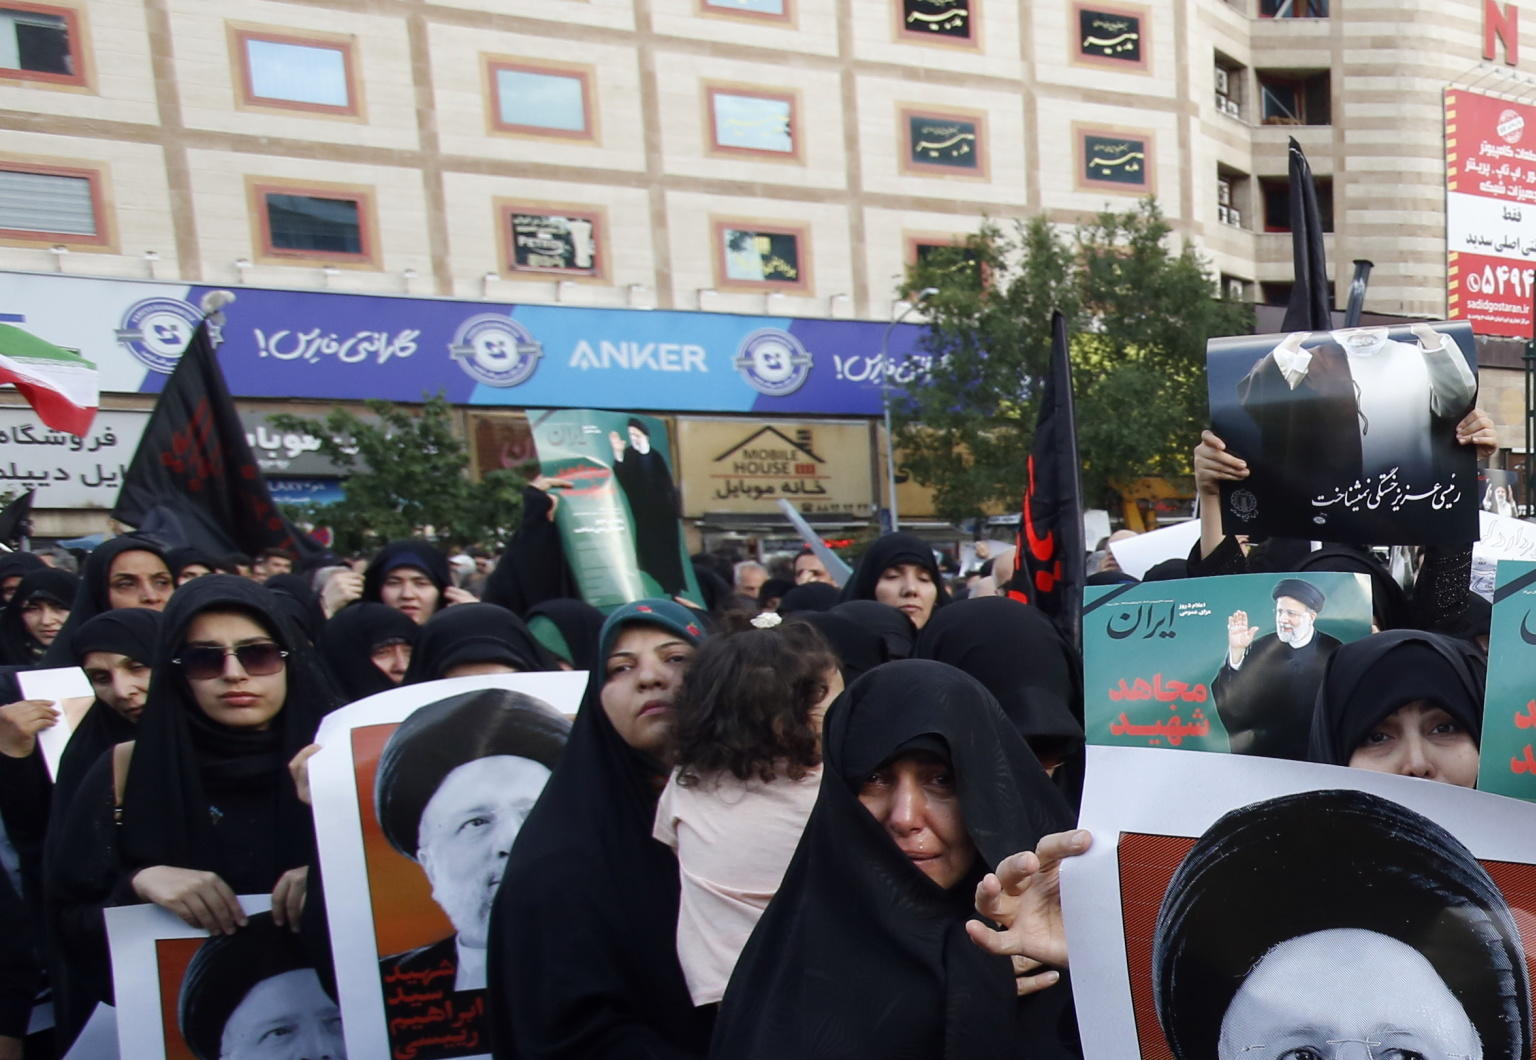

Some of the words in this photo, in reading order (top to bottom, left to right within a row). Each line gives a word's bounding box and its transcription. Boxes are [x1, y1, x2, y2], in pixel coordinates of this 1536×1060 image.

[1502, 206, 1522, 222] فقط
[1494, 235, 1520, 252] اصلی
[569, 340, 709, 373] ANKER
[742, 449, 798, 461] MOBILE
[733, 461, 791, 474] HOUSE
[716, 479, 775, 499] موبایل
[782, 480, 827, 496] خانه
[1107, 600, 1177, 640] ایران
[1109, 673, 1208, 711] مجاهد
[1110, 708, 1210, 746] شهید
[384, 959, 454, 985] شهید
[388, 986, 443, 1007] سید
[389, 997, 484, 1037] ابراهیم
